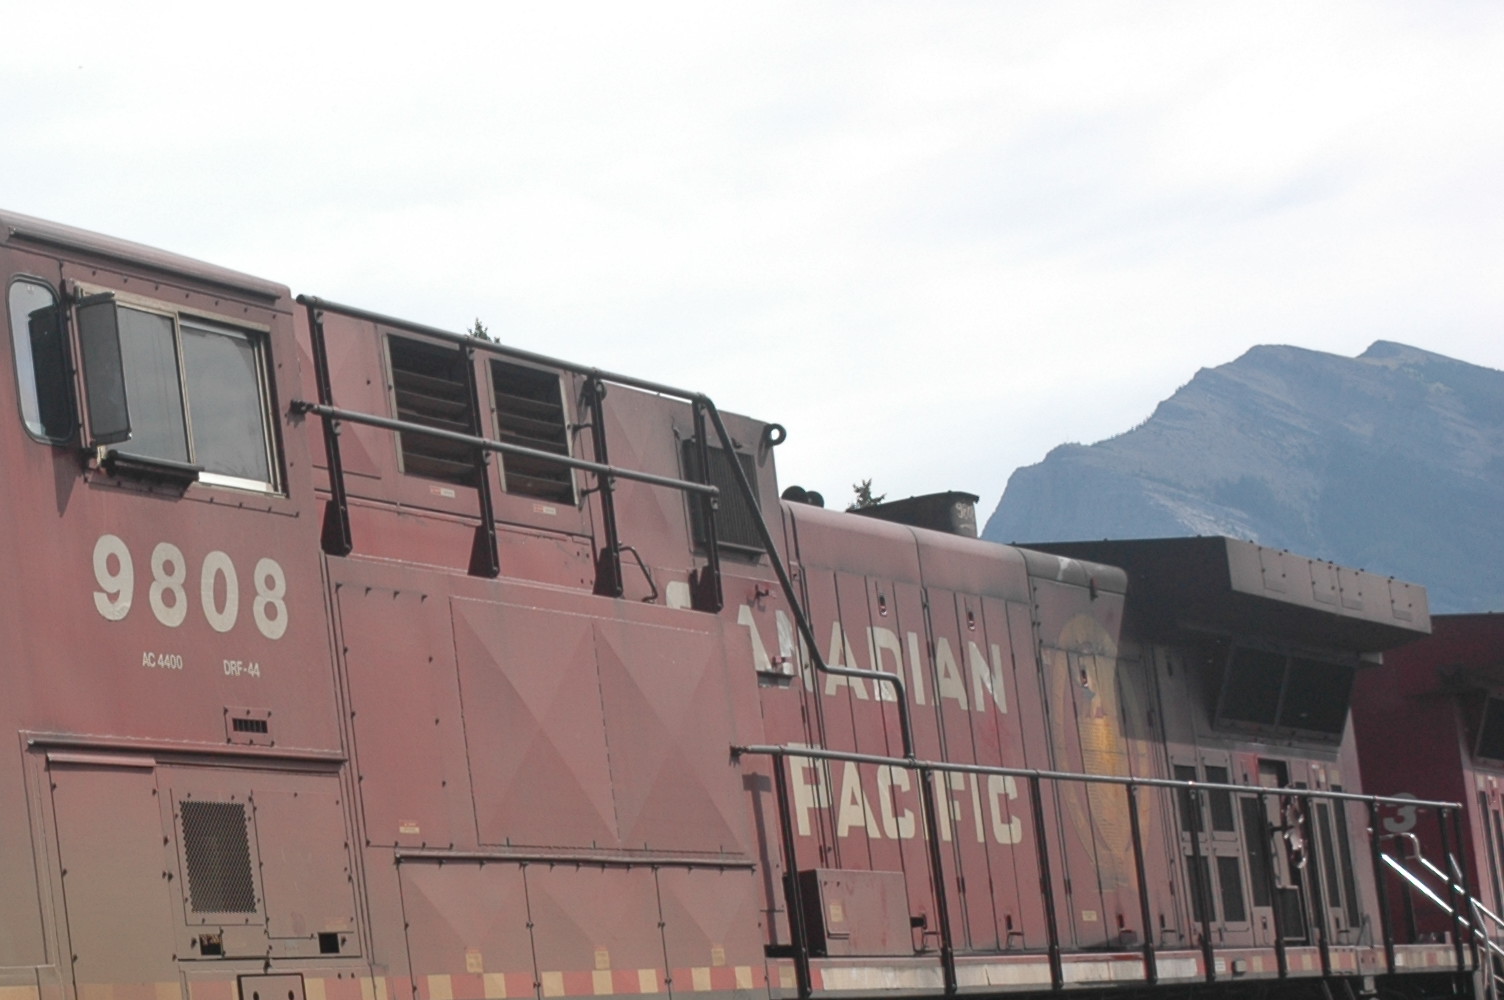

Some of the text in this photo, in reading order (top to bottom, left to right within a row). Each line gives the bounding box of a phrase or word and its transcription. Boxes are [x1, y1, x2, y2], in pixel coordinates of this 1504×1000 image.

[93, 534, 288, 640] 9808
[142, 652, 183, 670] AC 4400
[223, 660, 261, 677] DRF-44
